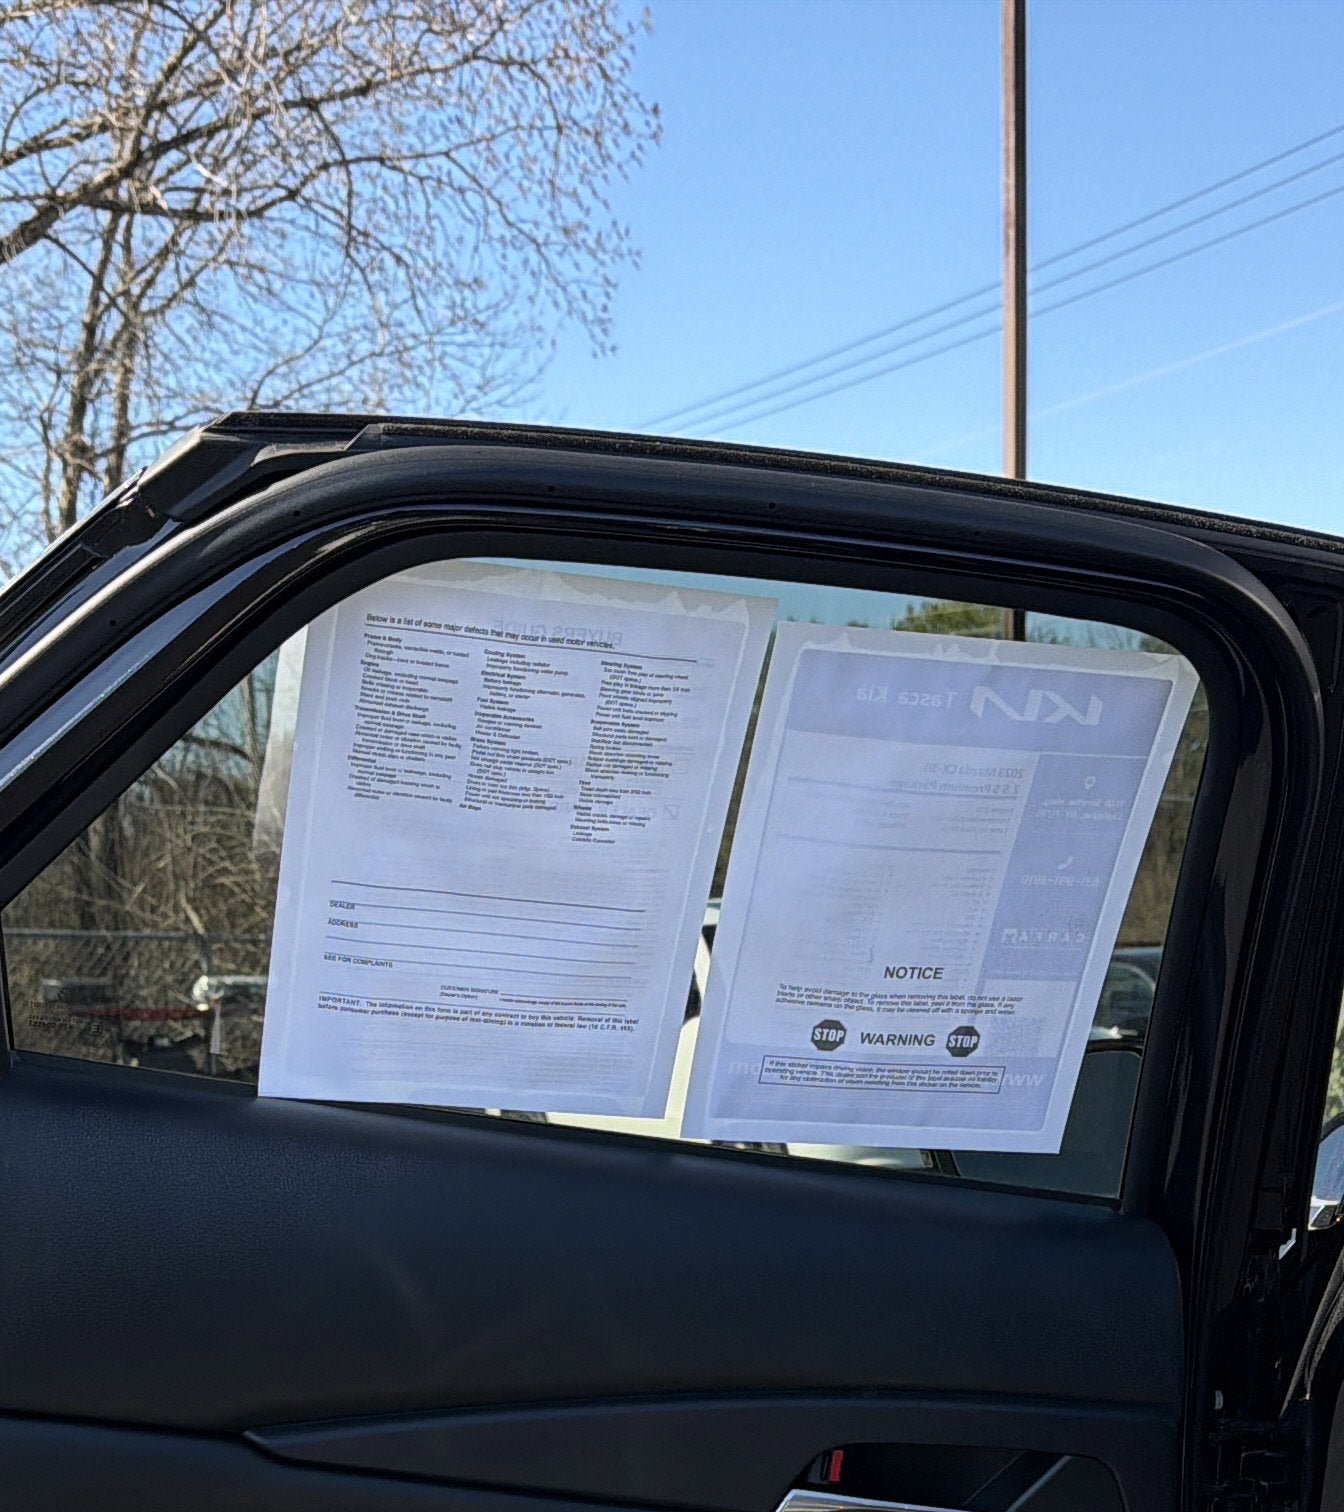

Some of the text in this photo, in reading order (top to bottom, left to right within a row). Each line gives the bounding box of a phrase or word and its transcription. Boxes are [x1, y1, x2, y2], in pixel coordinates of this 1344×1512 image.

[366, 613, 387, 622] Below
[403, 617, 413, 625] list
[443, 624, 463, 633] major
[490, 629, 503, 637] that
[504, 632, 519, 640] may
[329, 900, 355, 909] DEALER
[883, 965, 944, 979] NOTICE
[787, 984, 802, 992] help
[822, 988, 849, 997] damage
[813, 1028, 977, 1047] STOP WARNING STOP
